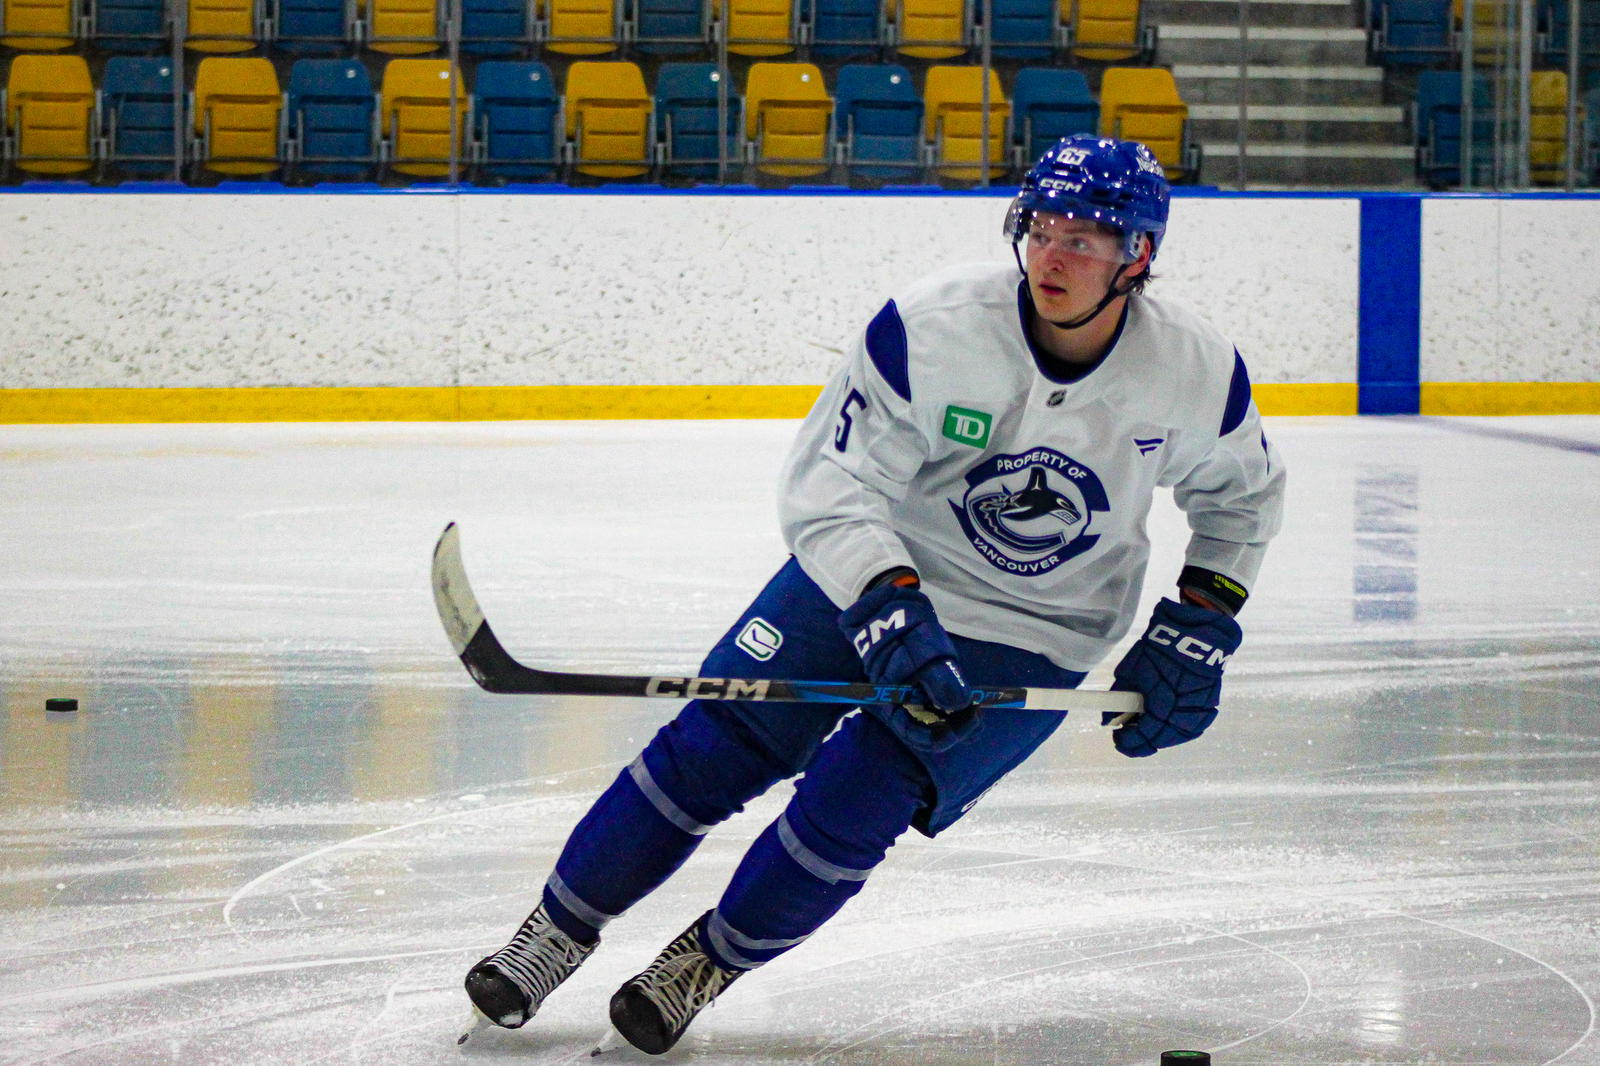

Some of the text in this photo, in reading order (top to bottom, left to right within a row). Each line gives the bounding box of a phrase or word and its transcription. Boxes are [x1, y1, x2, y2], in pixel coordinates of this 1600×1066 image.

[1056, 147, 1093, 166] 65
[1039, 177, 1083, 193] CCM
[835, 376, 867, 453] 5
[951, 413, 986, 440] TD
[997, 451, 1087, 479] PROPERTY OF
[973, 538, 1060, 572] VANCOUVER
[1148, 624, 1232, 671] CCM
[646, 676, 770, 701] CCM
